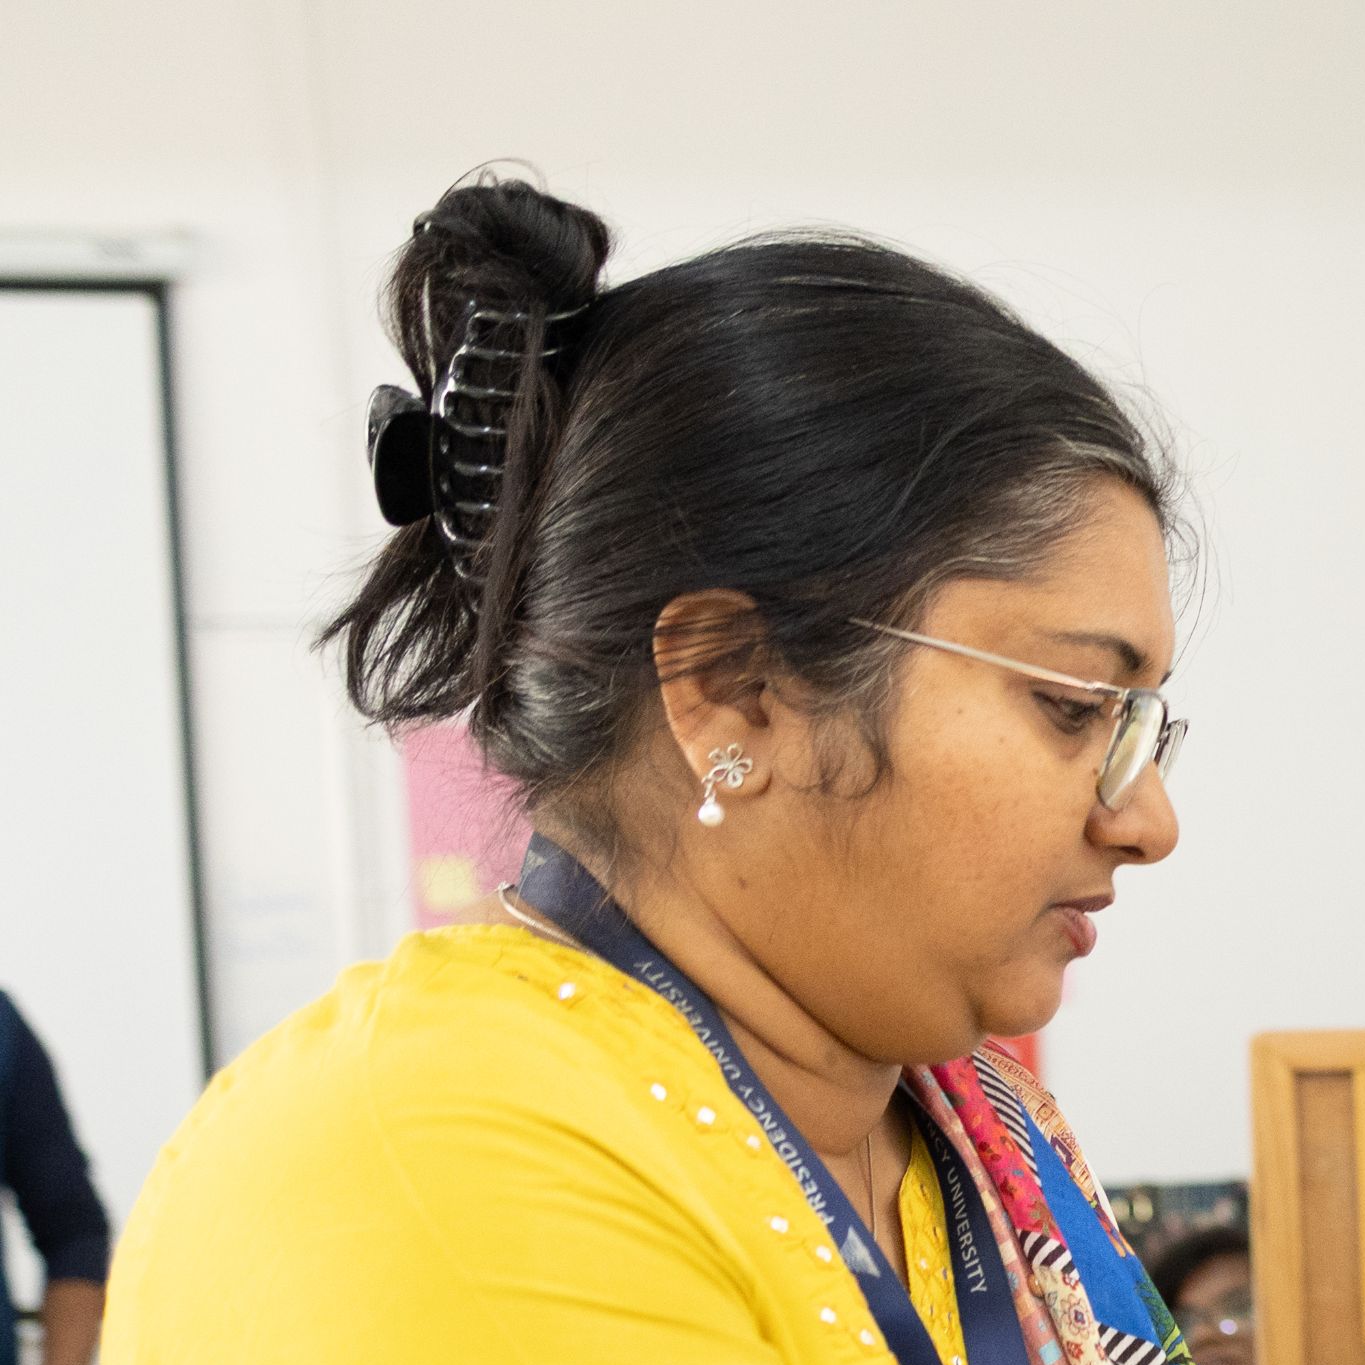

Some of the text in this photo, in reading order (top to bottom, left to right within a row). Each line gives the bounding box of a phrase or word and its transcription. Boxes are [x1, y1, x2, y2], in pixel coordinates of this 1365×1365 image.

[633, 960, 835, 1226] PRESIDENCY UNIVERSITY
[946, 1166, 988, 1294] UNIVERSITY
